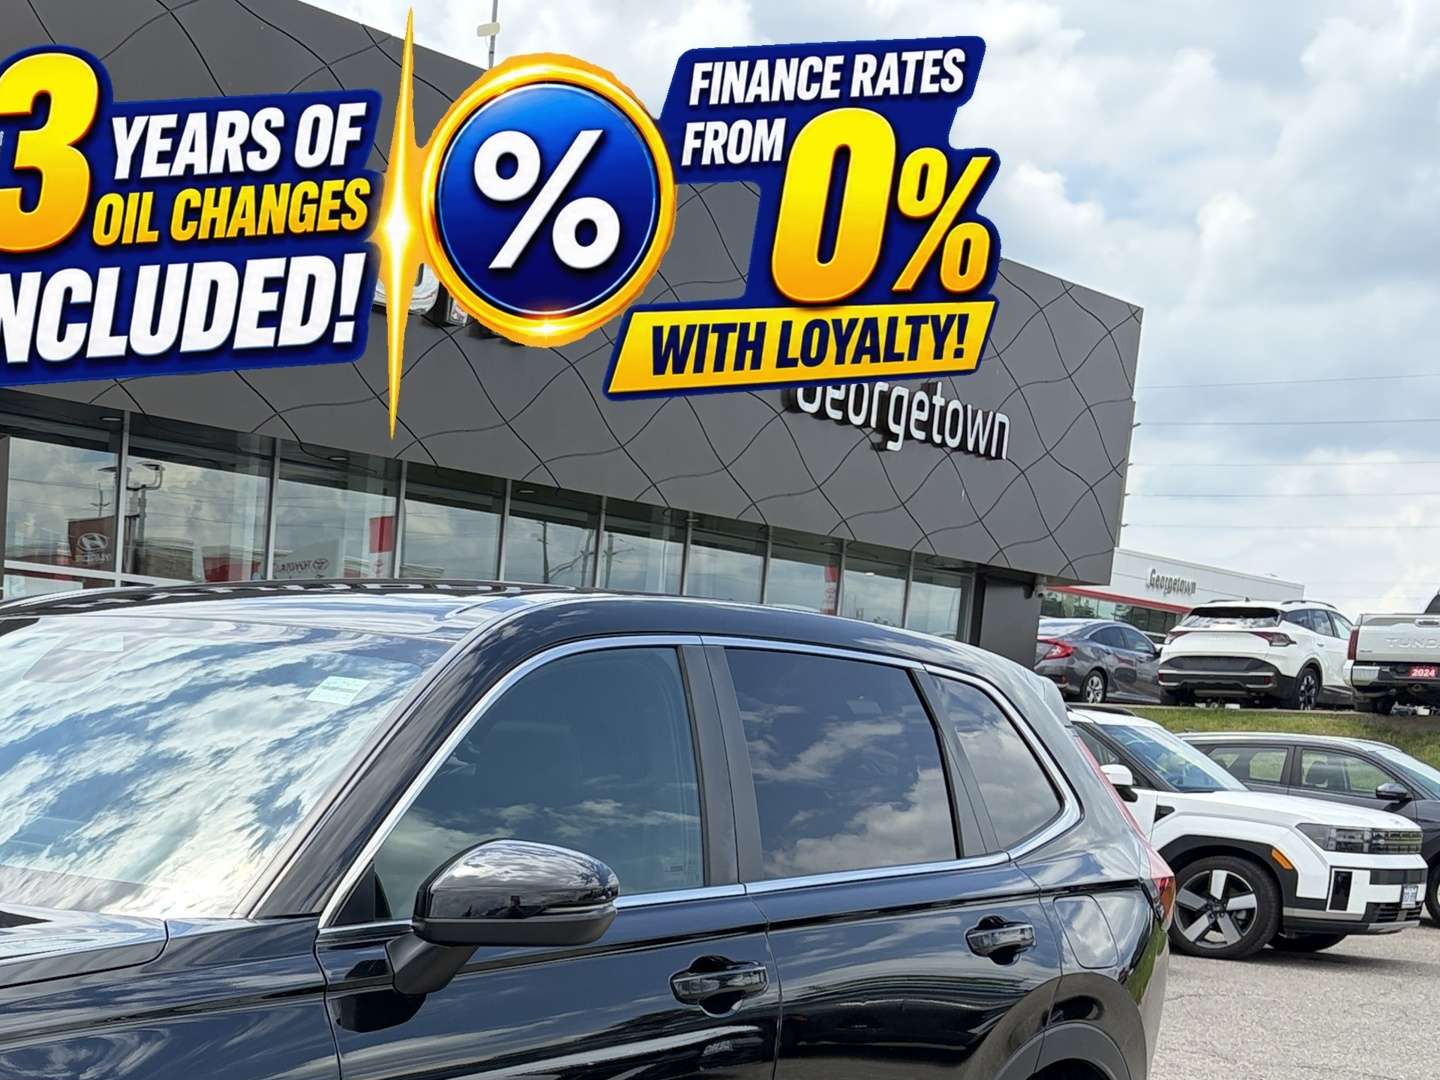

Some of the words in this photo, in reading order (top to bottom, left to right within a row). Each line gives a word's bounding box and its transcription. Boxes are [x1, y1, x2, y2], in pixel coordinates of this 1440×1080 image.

[1149, 568, 1197, 595] Georgetown
[1384, 637, 1440, 649] TUND
[1411, 667, 1436, 678] 2024
